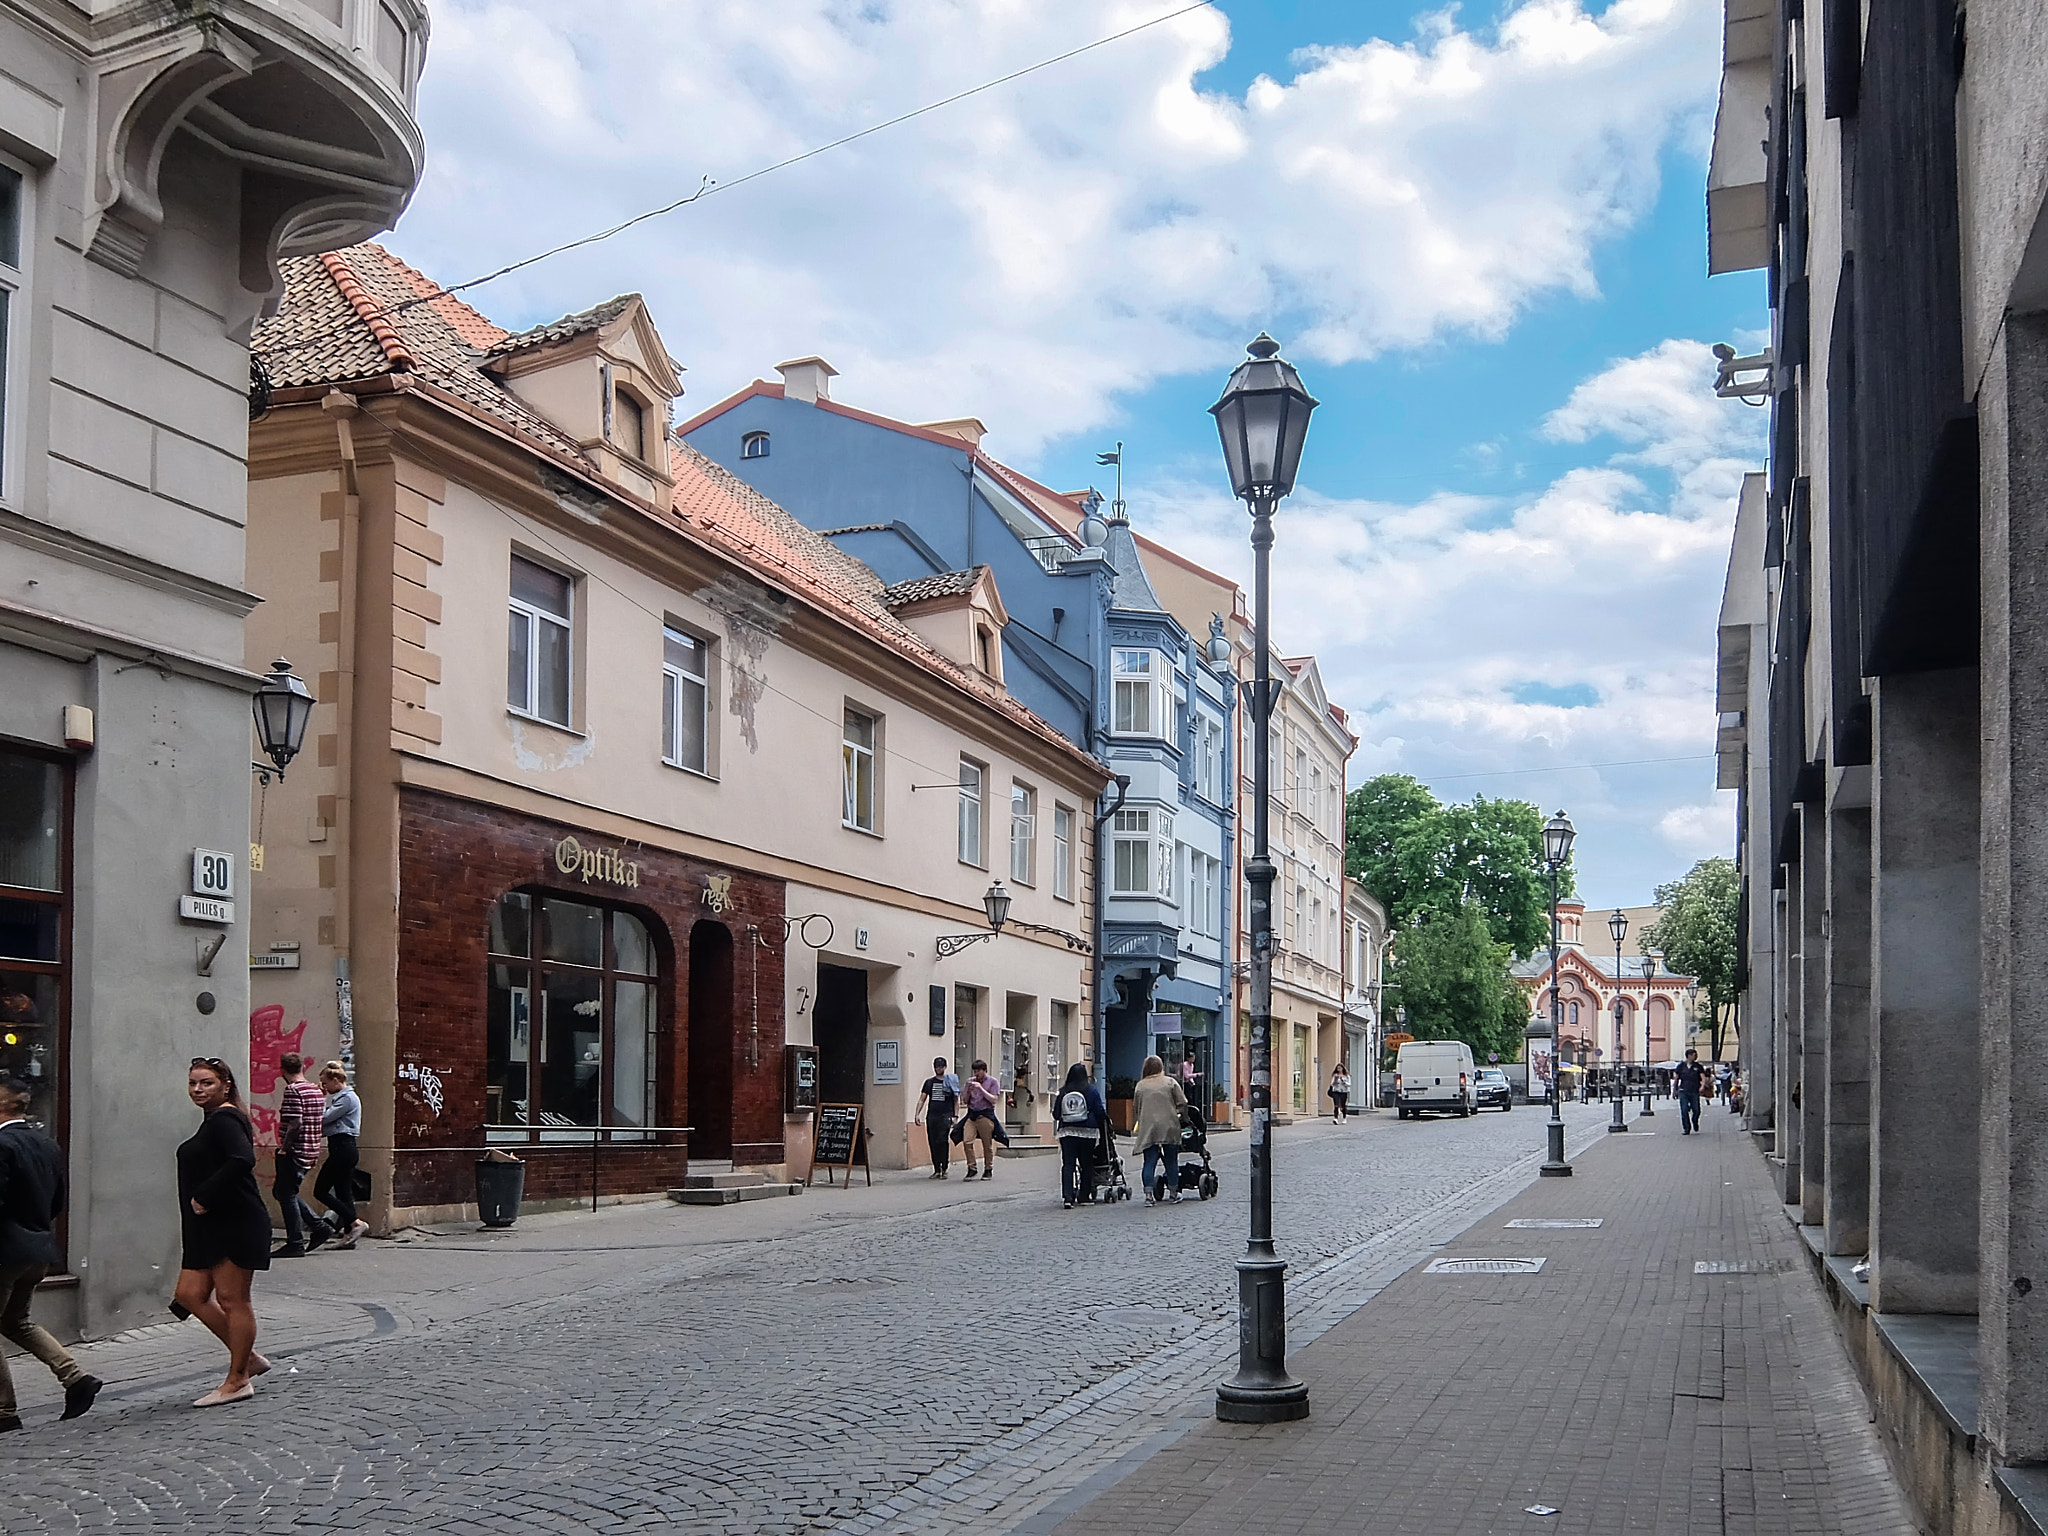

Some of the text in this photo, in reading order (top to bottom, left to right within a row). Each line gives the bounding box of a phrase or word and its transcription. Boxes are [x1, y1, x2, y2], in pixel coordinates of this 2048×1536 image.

[203, 855, 228, 890] 30
[555, 835, 639, 889] Optika
[193, 901, 218, 917] PILIES
[860, 930, 868, 946] 32
